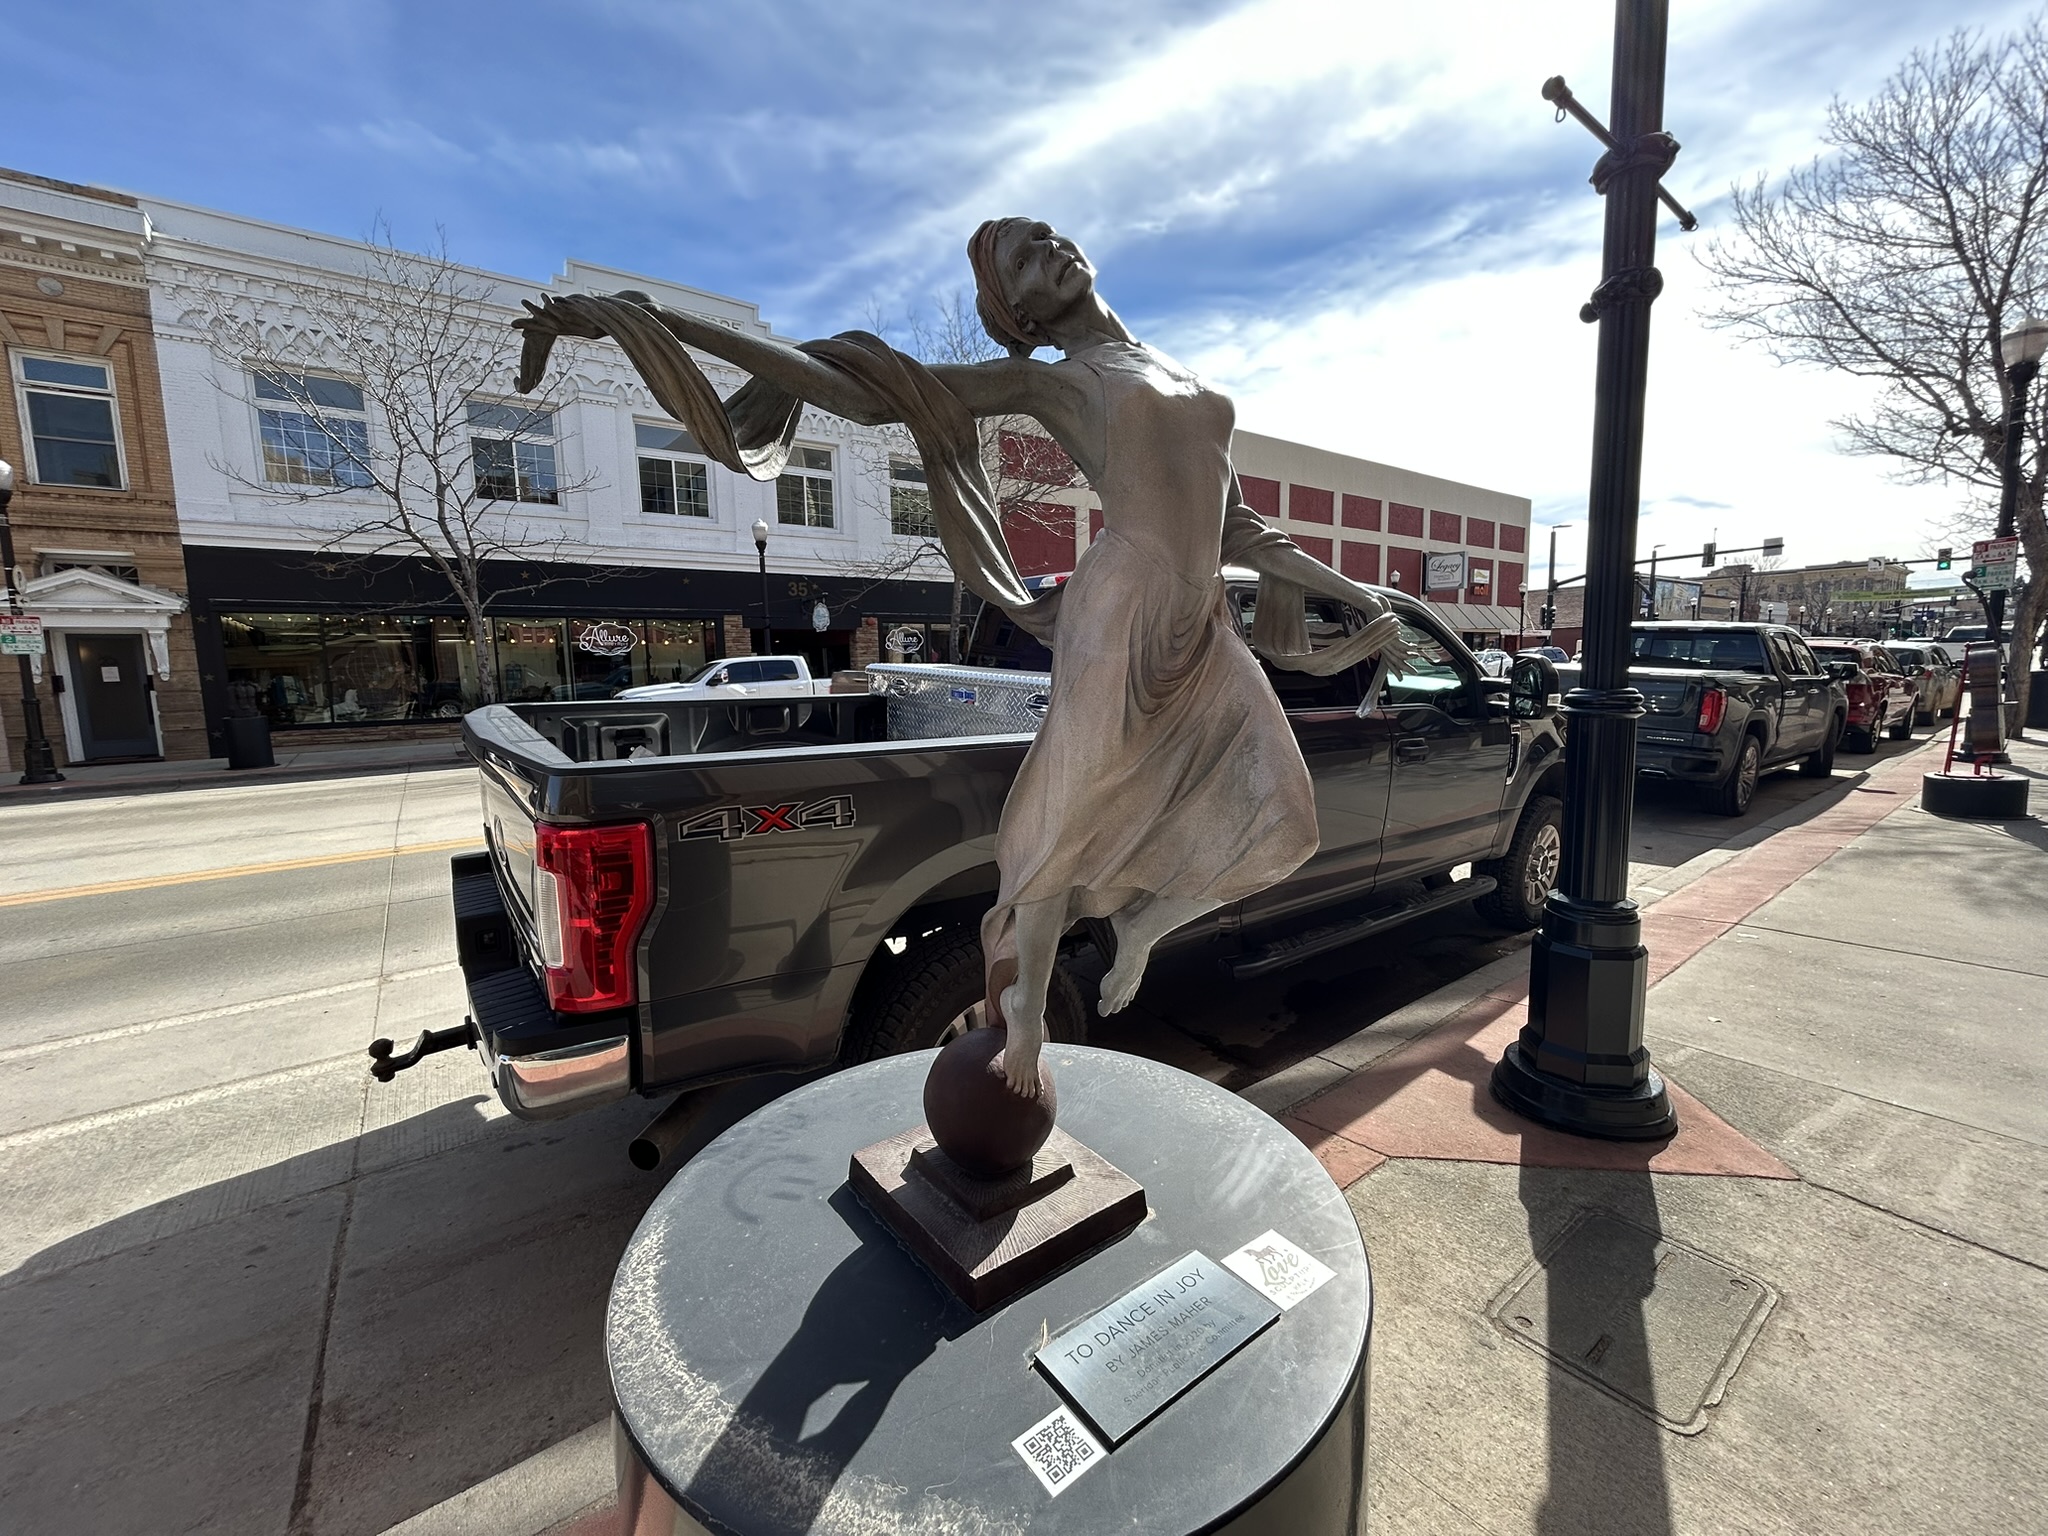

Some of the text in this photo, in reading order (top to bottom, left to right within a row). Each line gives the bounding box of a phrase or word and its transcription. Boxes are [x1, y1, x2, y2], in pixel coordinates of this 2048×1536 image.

[1430, 560, 1462, 573] Legacy
[586, 628, 629, 646] Allure
[890, 631, 918, 646] Allure
[1260, 1253, 1298, 1287] Love
[1064, 1268, 1204, 1364] TO DANCE IN JOY
[1203, 1318, 1217, 1330] by
[1105, 1296, 1213, 1373] BY JAMES MAHER
[1123, 1375, 1163, 1406] Sheridan
[1162, 1356, 1187, 1377] Public
[1204, 1314, 1246, 1345] Committee
